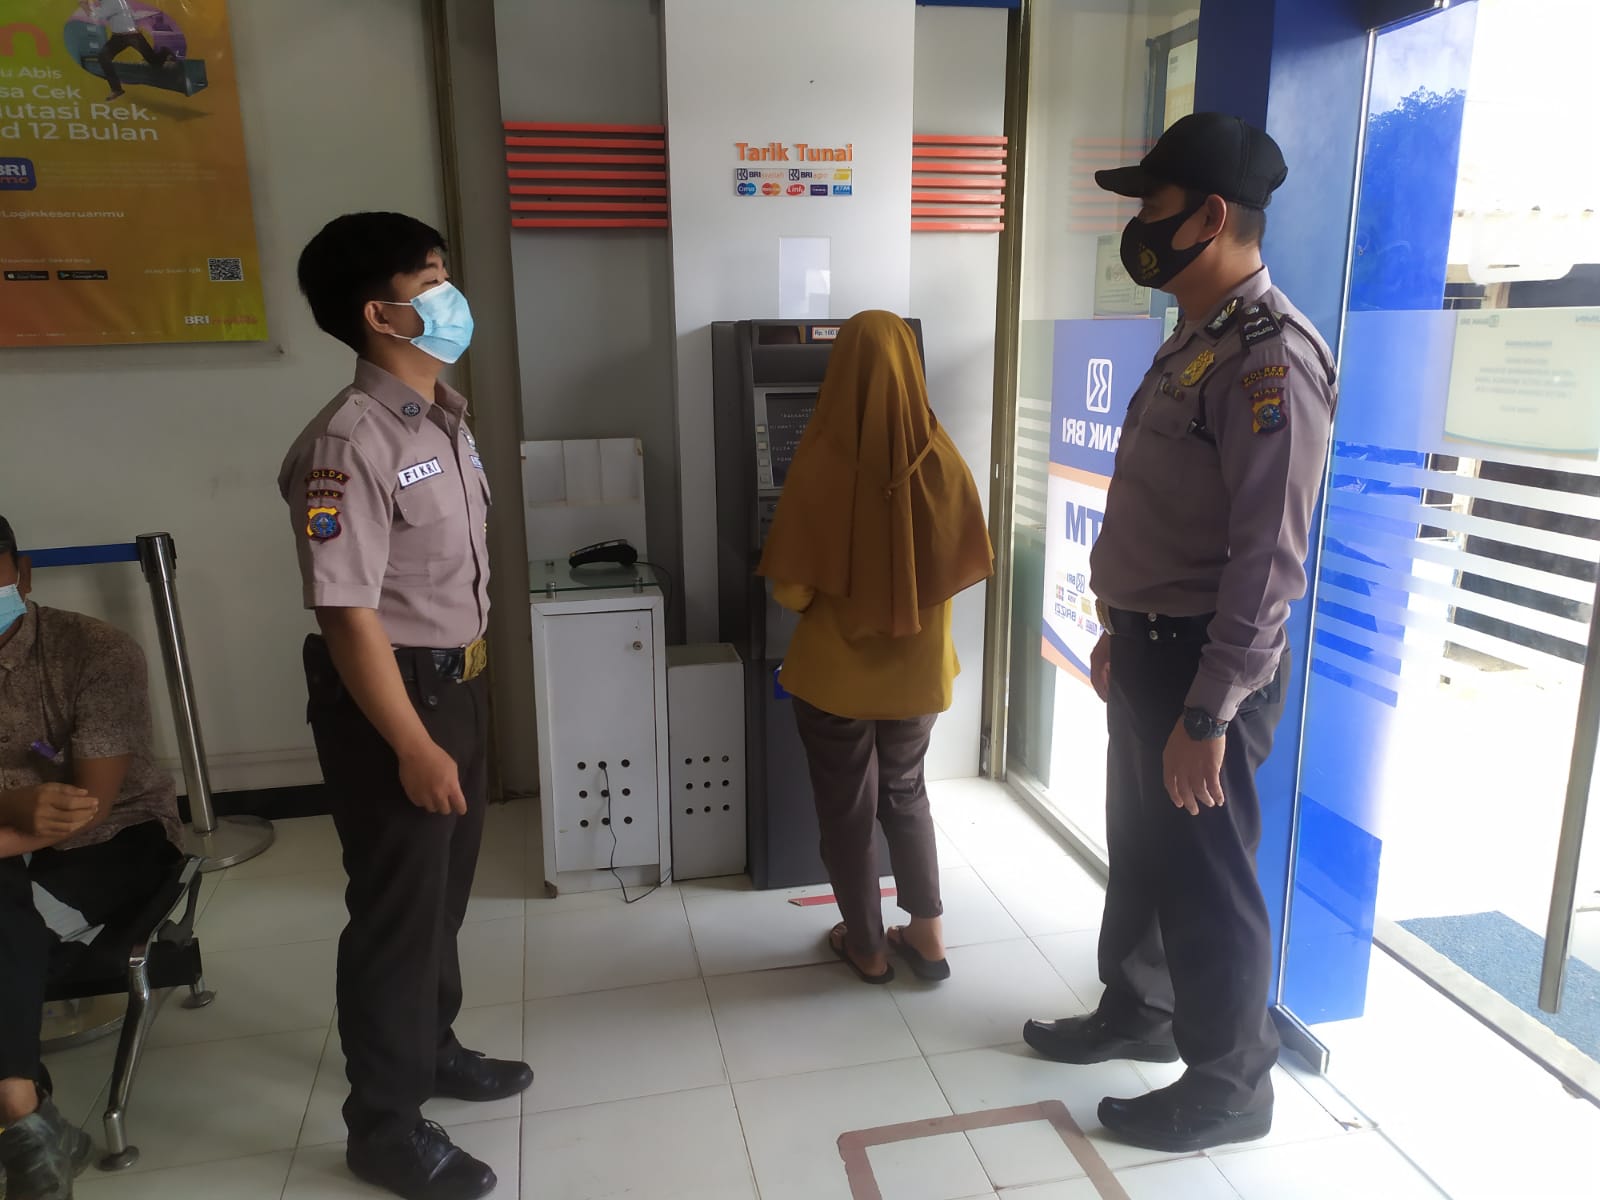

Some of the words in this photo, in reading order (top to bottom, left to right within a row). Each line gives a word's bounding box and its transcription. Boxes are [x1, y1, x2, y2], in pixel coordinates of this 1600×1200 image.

[18, 66, 63, 79] Abis
[32, 84, 82, 99] Cek
[0, 102, 81, 119] utasi
[91, 103, 157, 120] Rek.
[28, 122, 59, 139] 12
[68, 122, 158, 141] Bulan
[736, 142, 789, 161] Tarik
[794, 143, 853, 162] Tunai
[184, 315, 209, 325] BRI
[308, 470, 344, 481] OLDA
[403, 461, 438, 484] FIKRI
